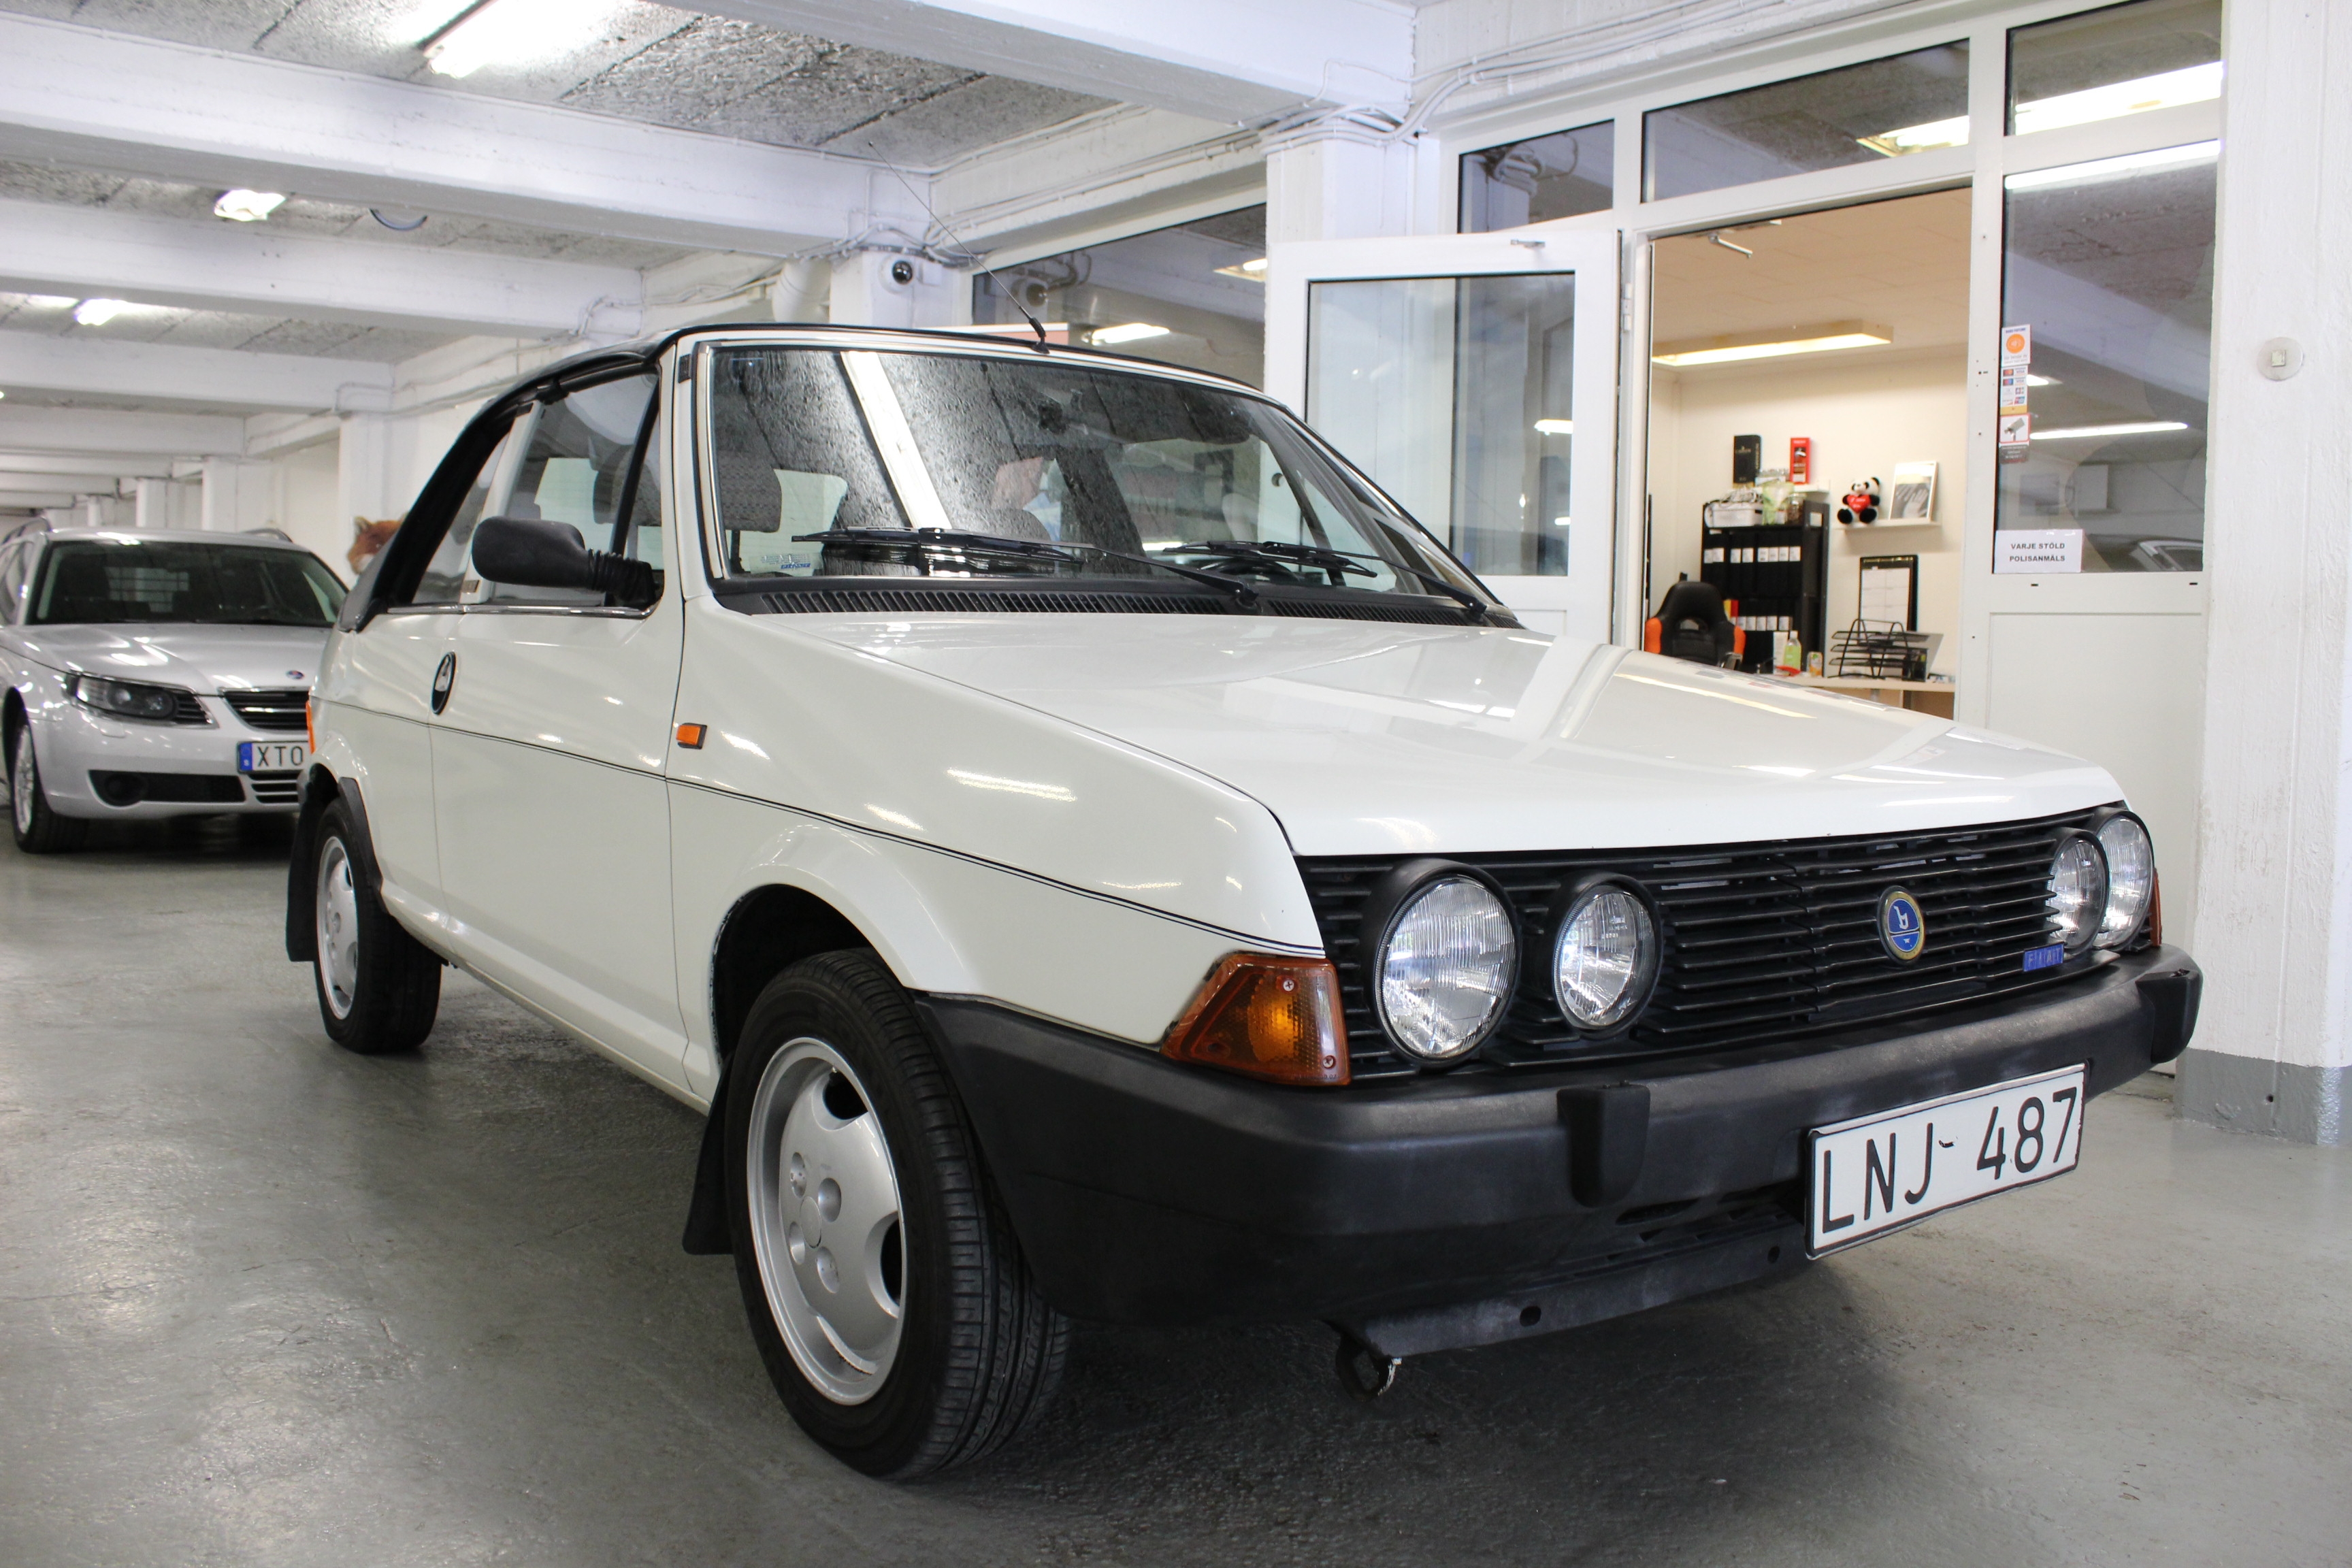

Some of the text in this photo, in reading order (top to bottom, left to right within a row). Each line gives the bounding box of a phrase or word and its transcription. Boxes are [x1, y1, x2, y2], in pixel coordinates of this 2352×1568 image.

[257, 745, 304, 766] XTO
[2028, 947, 2061, 967] FIAT
[1823, 1087, 2077, 1234] LNJ 487
